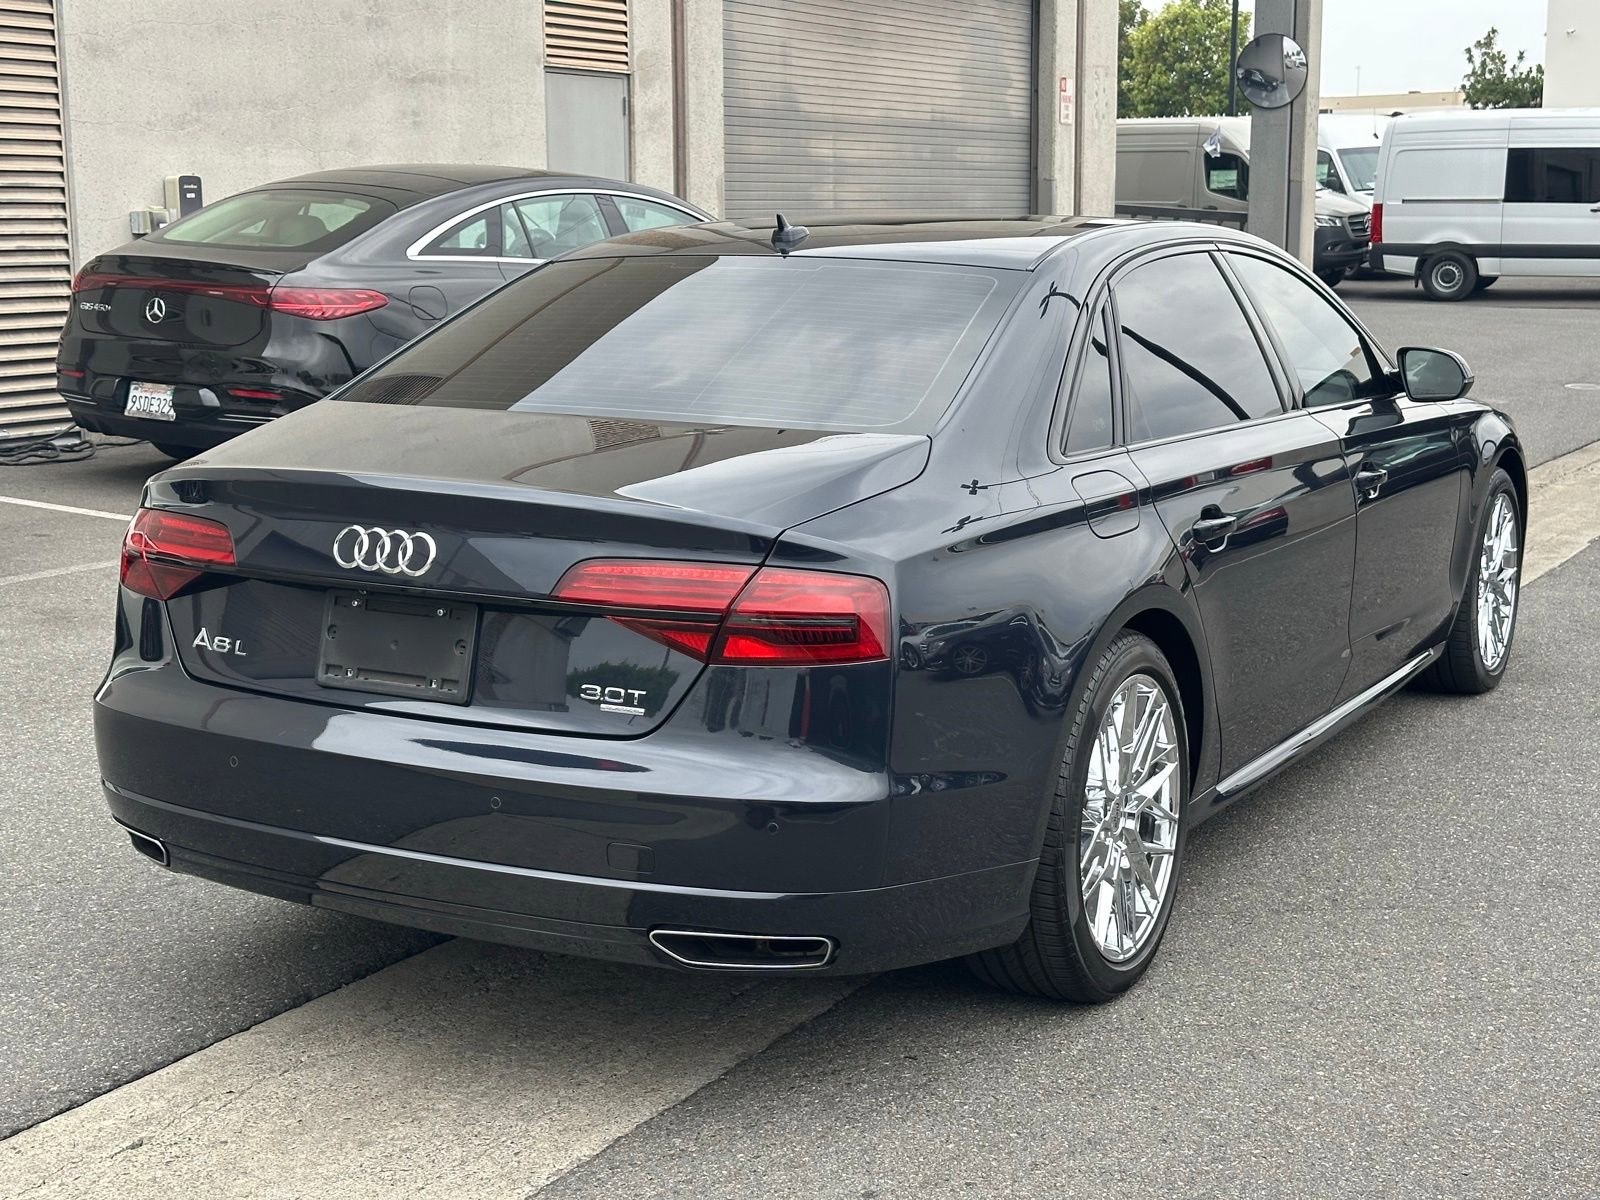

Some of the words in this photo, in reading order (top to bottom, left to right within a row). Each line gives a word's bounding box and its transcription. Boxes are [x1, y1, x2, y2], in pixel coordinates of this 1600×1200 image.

[192, 627, 231, 653] A8
[234, 639, 248, 657] L
[580, 684, 647, 706] 3.0T
